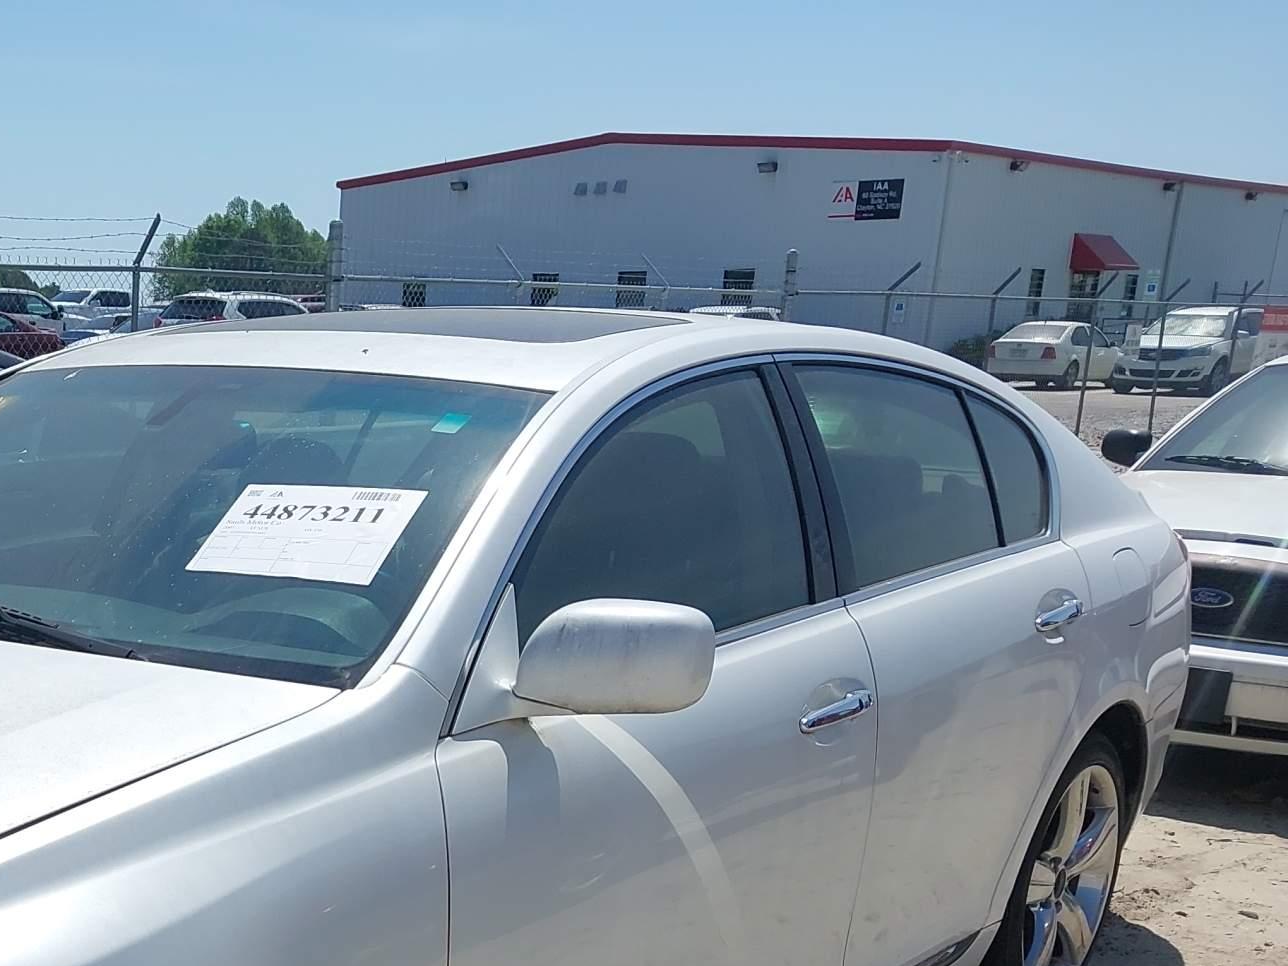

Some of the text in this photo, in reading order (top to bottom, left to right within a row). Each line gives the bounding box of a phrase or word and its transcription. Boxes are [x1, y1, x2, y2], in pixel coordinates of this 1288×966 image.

[873, 182, 889, 191] IAA
[243, 504, 385, 523] 44873211
[1194, 591, 1222, 604] Ford
